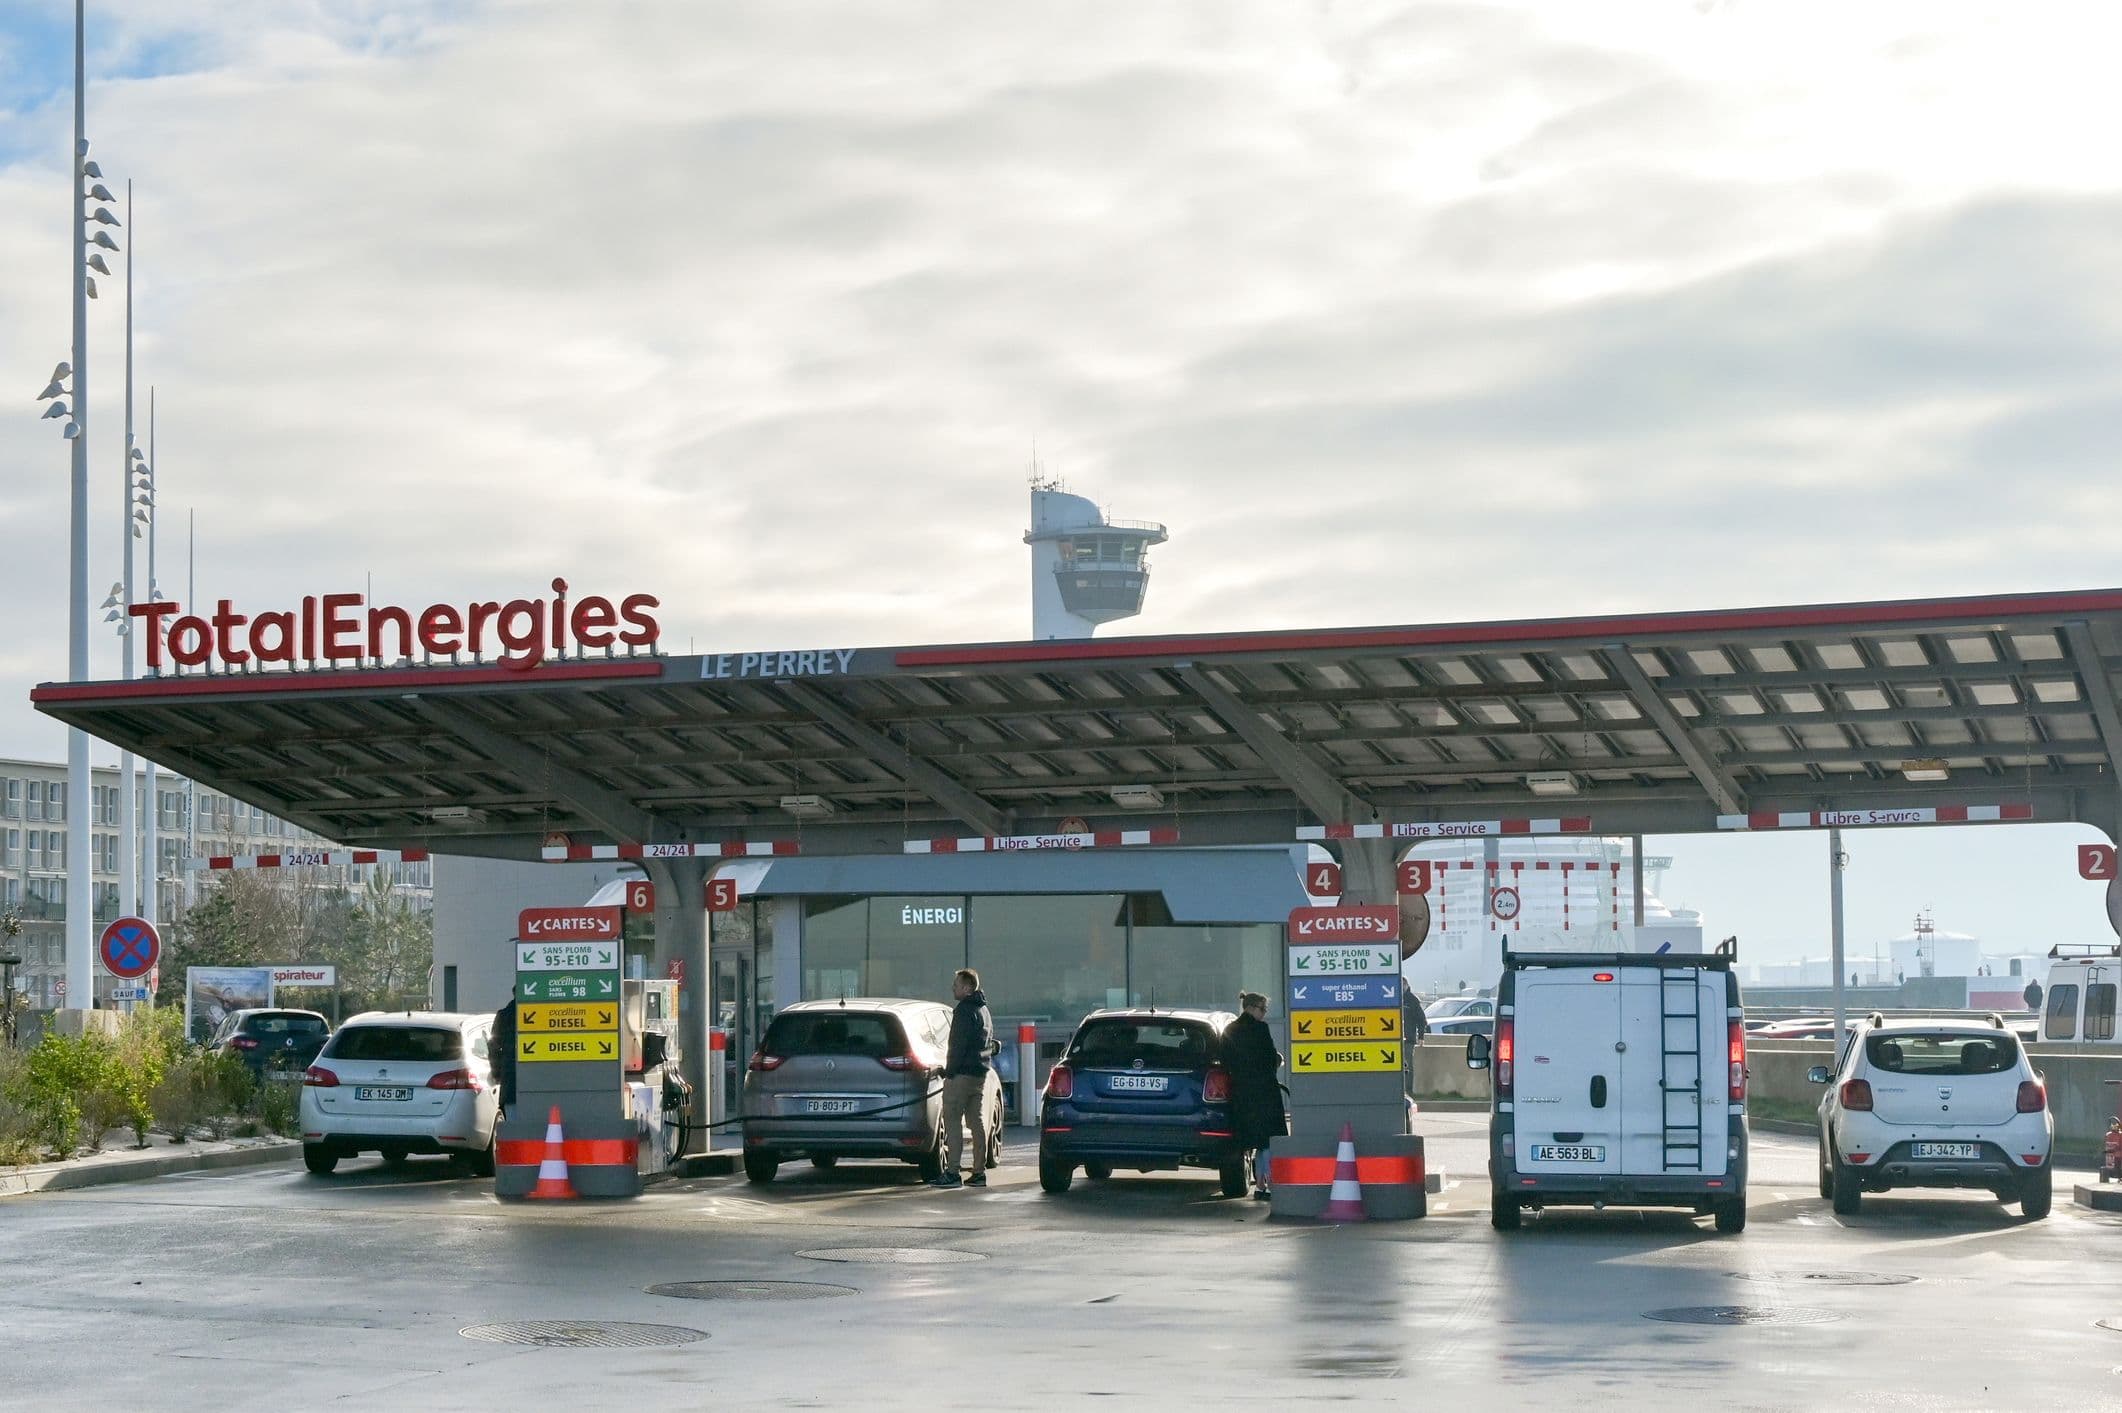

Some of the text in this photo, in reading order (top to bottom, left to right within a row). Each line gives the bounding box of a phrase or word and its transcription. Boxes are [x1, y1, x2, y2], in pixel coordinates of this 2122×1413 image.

[128, 576, 662, 671] TotalEnergies
[700, 649, 857, 679] LE PERREY
[1826, 813, 1861, 825] Libre
[1396, 821, 1487, 837] Libre Service
[998, 835, 1081, 849] Libre Service
[652, 845, 686, 857] 24/24
[289, 854, 320, 866] 24/24
[2088, 850, 2105, 874] 2
[1315, 868, 1332, 891] 4
[1407, 865, 1422, 889] 3
[634, 886, 647, 908] 6
[715, 884, 728, 906] 5
[902, 905, 962, 925] ÉNERGI
[543, 918, 595, 930] CARTES
[1315, 917, 1373, 930] CARTES
[565, 946, 592, 954] PLOMB
[1316, 949, 1371, 958] SANS PLOMB
[545, 955, 589, 966] 95-E10
[1320, 959, 1368, 971] 95-E10
[273, 970, 326, 982] spirateur
[548, 976, 586, 986] excellium
[572, 987, 587, 997] 98
[1335, 992, 1354, 1002] E85
[549, 1008, 586, 1016] excellium
[548, 1019, 586, 1028] DIESEL
[1325, 1015, 1366, 1024] excellium
[1325, 1026, 1366, 1037] DIESEL
[549, 1042, 586, 1052] DIESEL
[1325, 1052, 1367, 1063] DIESEL
[1113, 1077, 1161, 1088] EG-618-VS
[1540, 1147, 1597, 1160] AE-563-BL
[1920, 1145, 1972, 1156] EJ-342-YP
